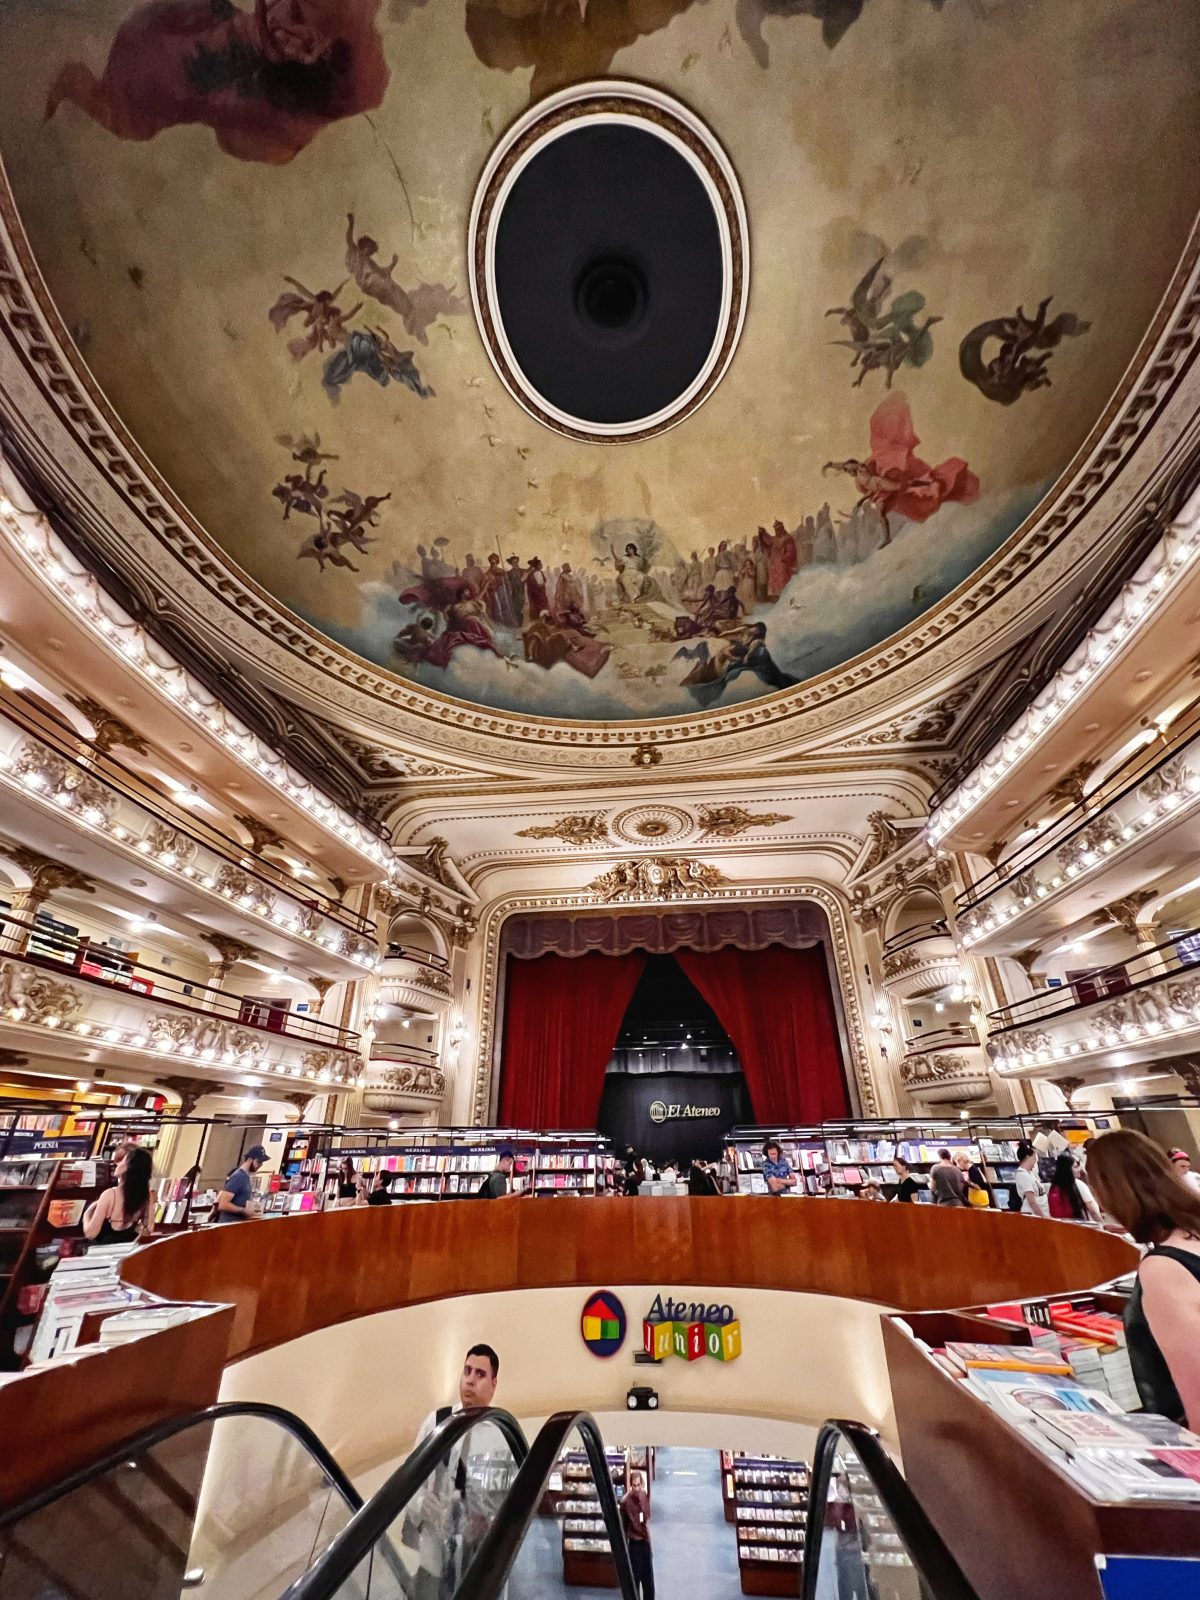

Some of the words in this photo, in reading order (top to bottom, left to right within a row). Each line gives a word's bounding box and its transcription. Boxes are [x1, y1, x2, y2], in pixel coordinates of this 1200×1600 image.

[667, 1104, 681, 1118] El
[682, 1104, 721, 1117] Ateneo
[646, 1293, 734, 1323] Ateneo
[644, 1323, 739, 1354] Junior
